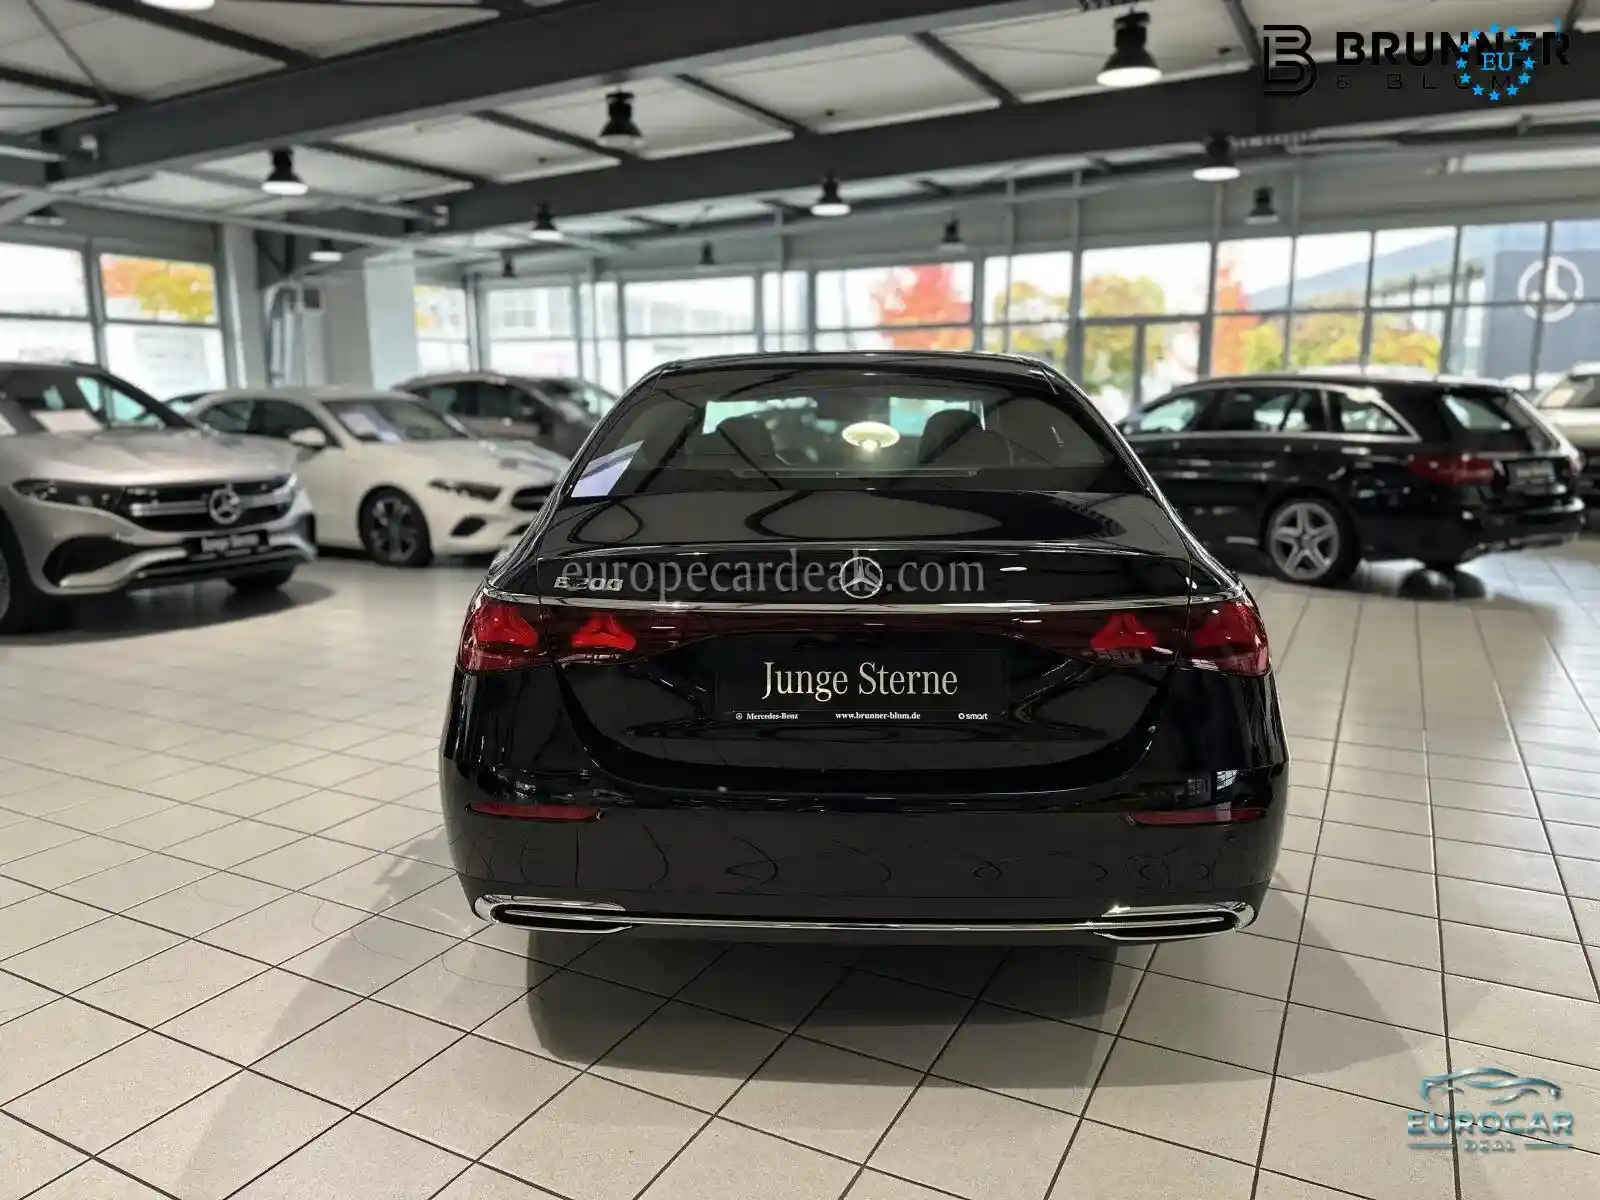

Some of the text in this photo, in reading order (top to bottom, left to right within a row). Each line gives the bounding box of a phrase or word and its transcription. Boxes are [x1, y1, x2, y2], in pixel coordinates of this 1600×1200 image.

[761, 661, 958, 702] Junge Sterne
[746, 712, 799, 720] Mercedes-Benz
[835, 711, 921, 720] www.brunner-blum.de
